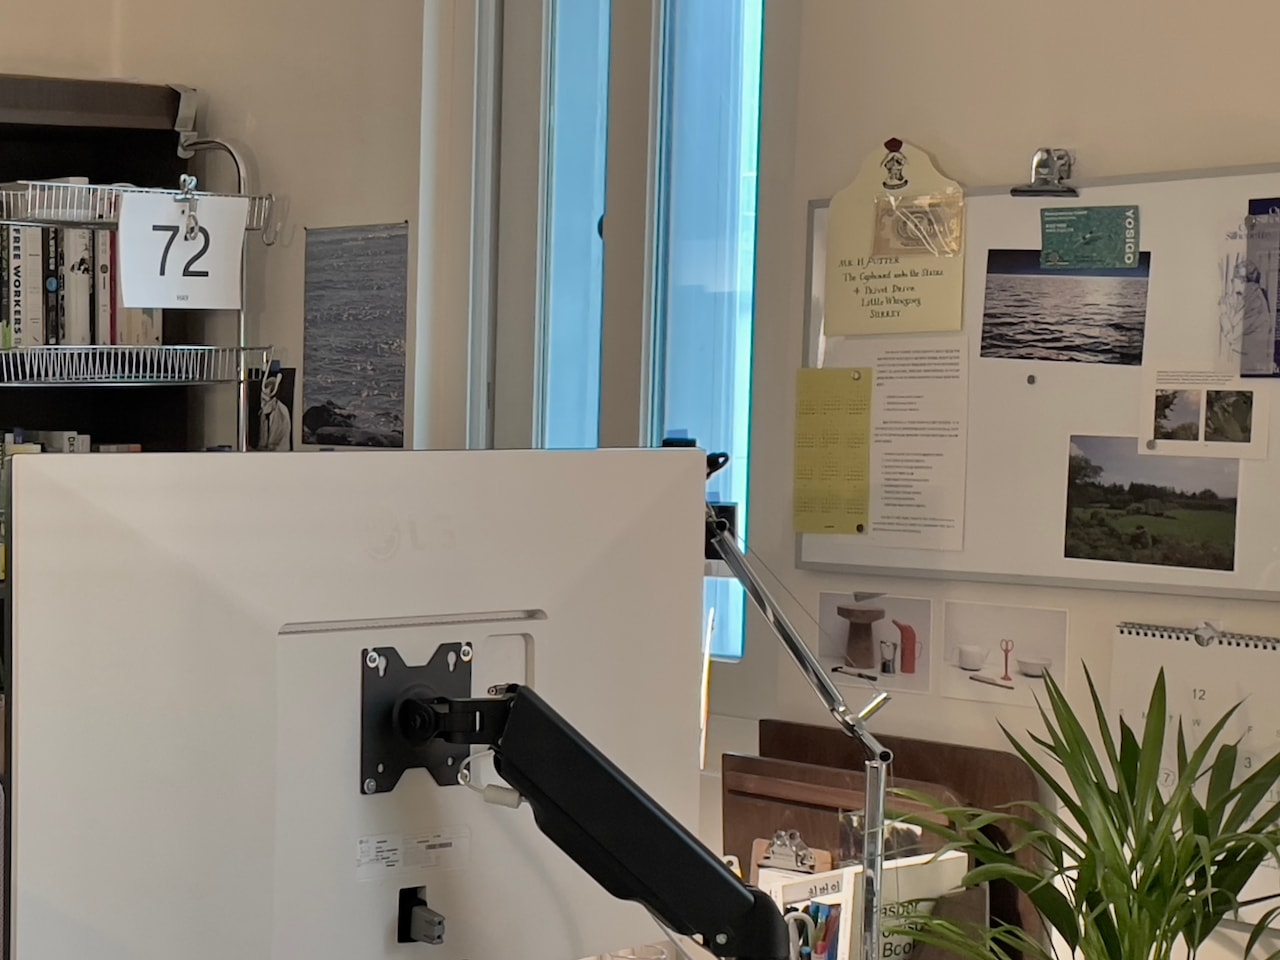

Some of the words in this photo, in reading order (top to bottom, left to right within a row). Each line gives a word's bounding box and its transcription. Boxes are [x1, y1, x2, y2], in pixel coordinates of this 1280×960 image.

[1124, 209, 1135, 264] YOSIGO
[12, 228, 21, 260] FREE
[152, 224, 210, 277] 72
[843, 272, 856, 282] The
[13, 265, 22, 334] WORKERS
[861, 298, 883, 307] Little
[1192, 689, 1206, 700] 12
[1192, 719, 1201, 727] W
[1247, 726, 1253, 734] F
[1244, 757, 1252, 769] 3
[1163, 773, 1170, 783] 7
